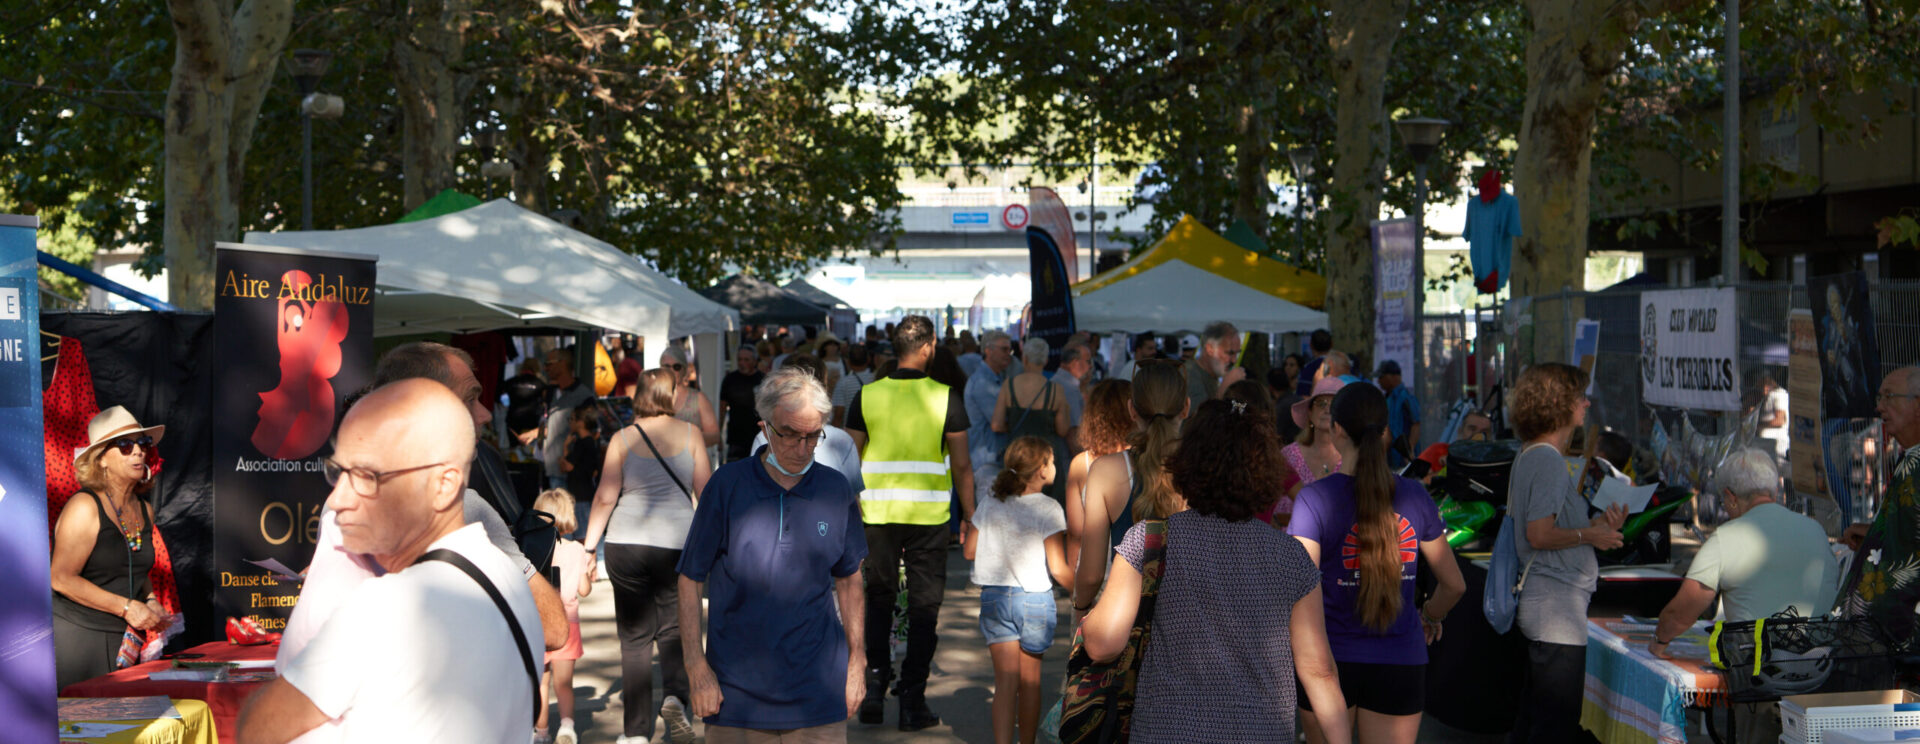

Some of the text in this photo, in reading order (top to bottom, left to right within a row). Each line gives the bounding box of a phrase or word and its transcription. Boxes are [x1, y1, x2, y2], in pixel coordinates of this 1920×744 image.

[220, 269, 370, 305] Aire Andaluz
[1660, 356, 1733, 392] LES TERRIBLES
[235, 456, 302, 472] Association
[221, 571, 260, 587] Danse
